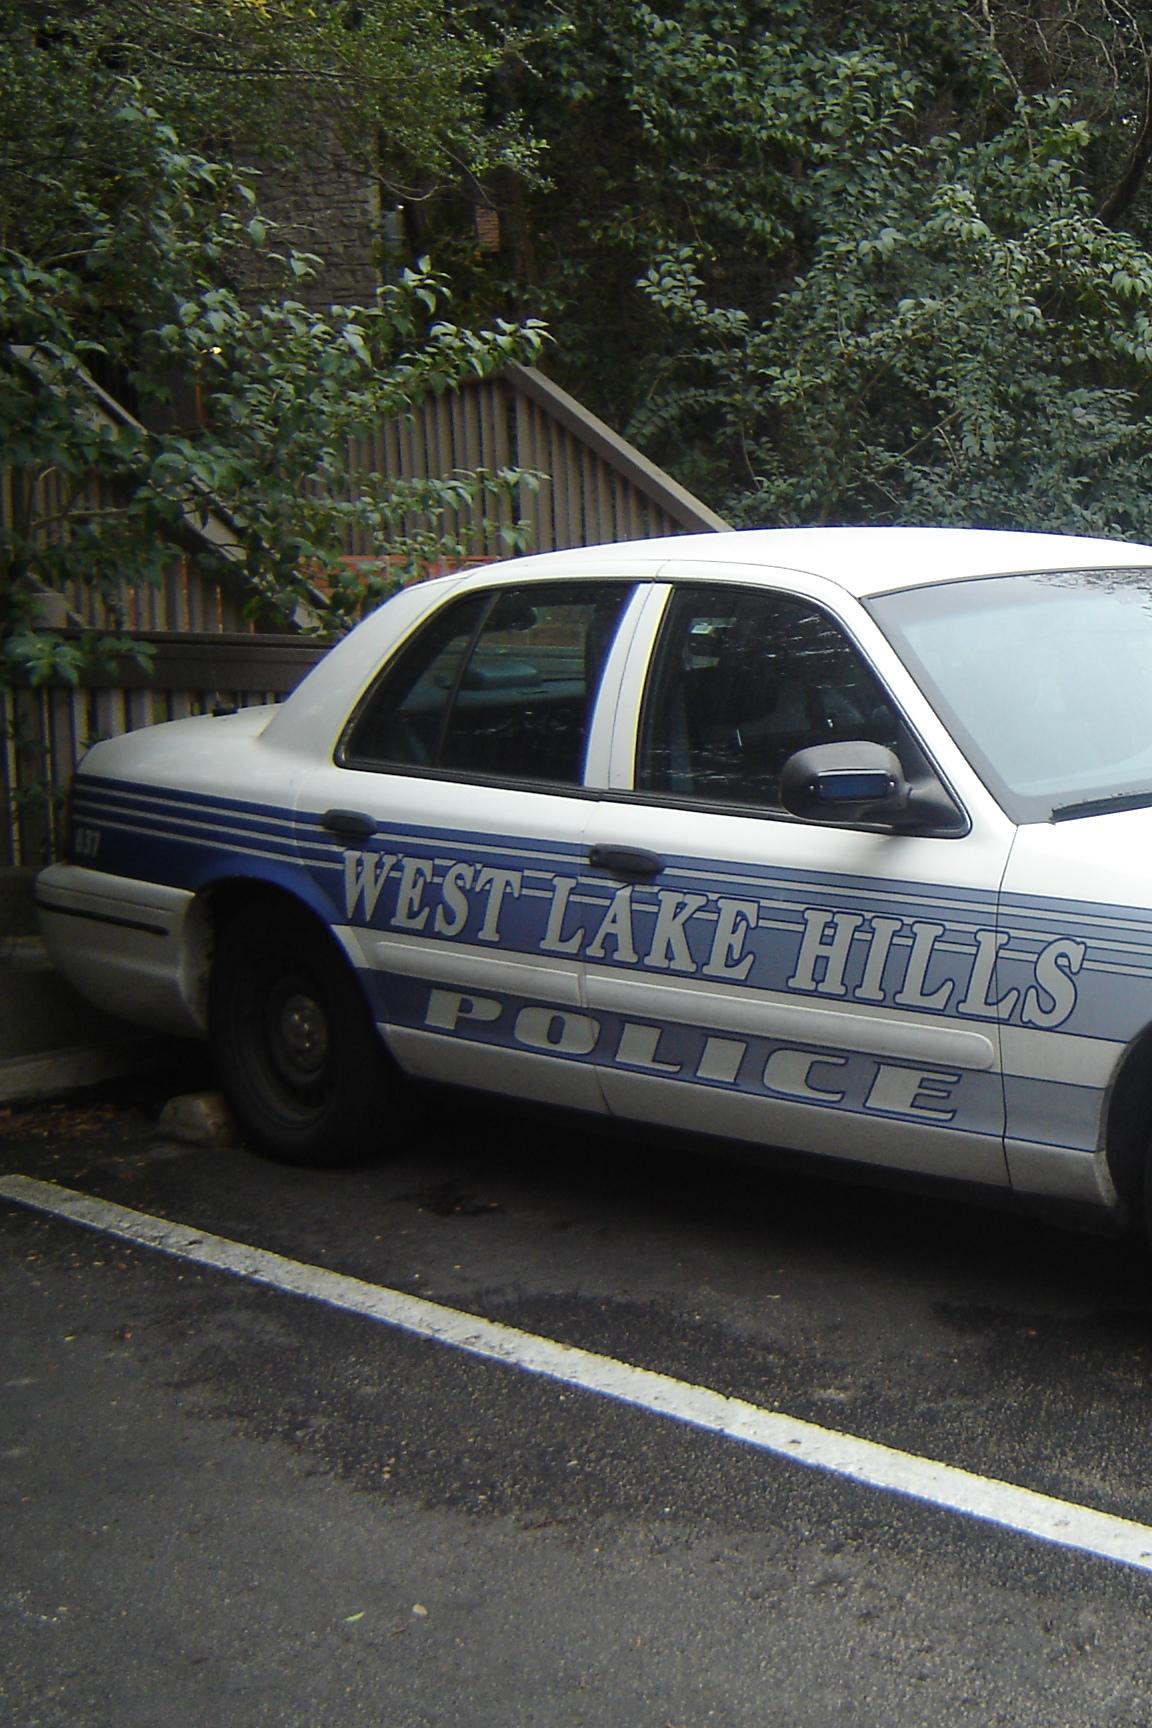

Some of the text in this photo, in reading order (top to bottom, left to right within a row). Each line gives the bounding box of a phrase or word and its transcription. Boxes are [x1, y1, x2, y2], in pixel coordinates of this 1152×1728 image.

[343, 849, 1087, 1028] WEST LAKE HILLS
[424, 988, 962, 1121] POLICE
